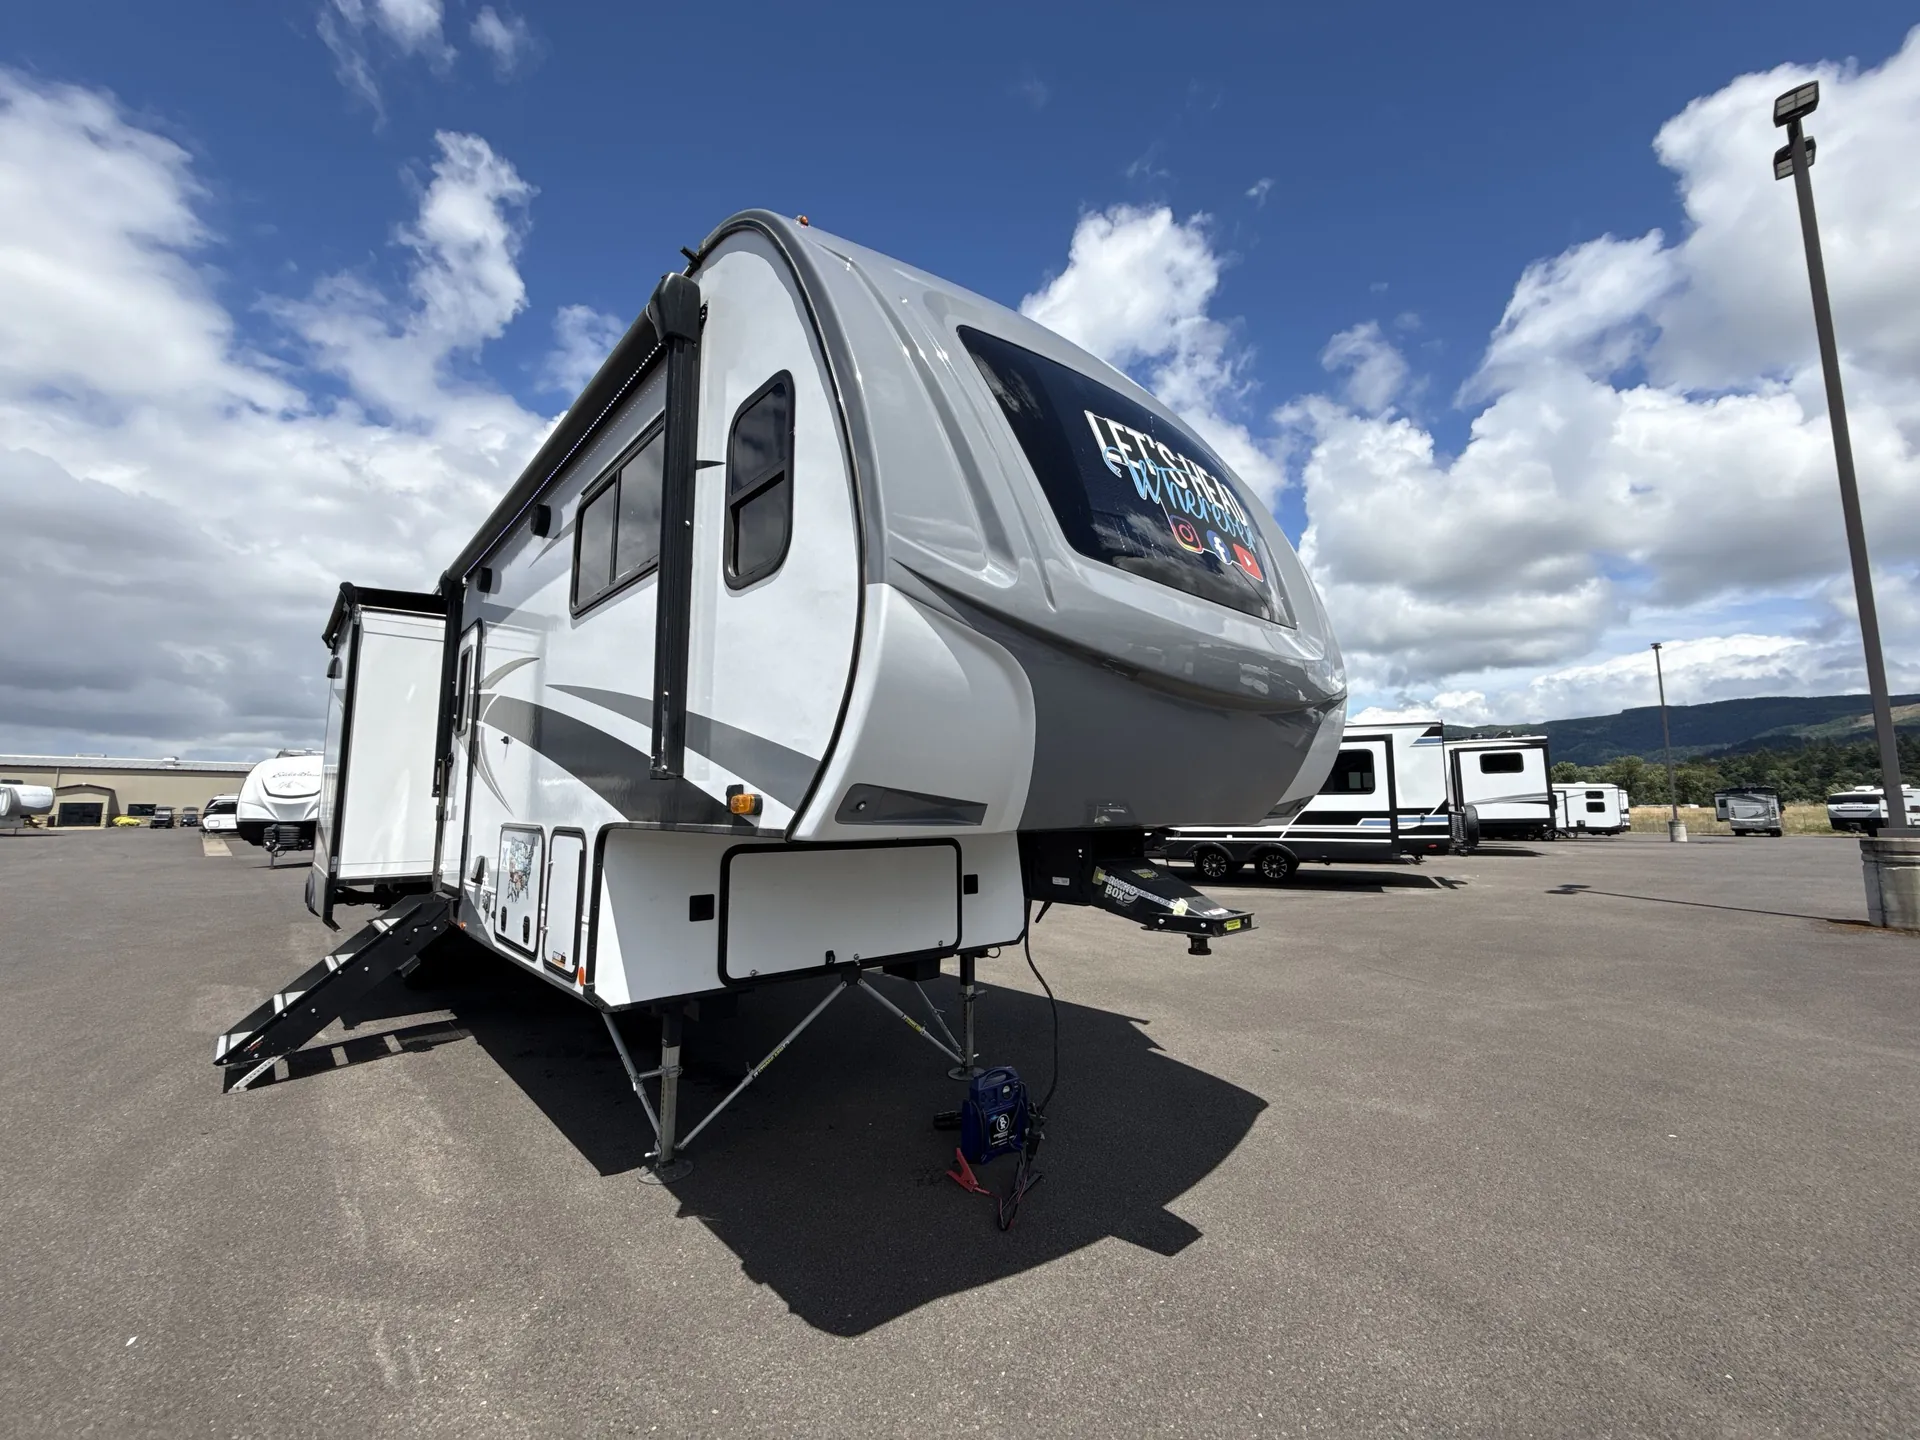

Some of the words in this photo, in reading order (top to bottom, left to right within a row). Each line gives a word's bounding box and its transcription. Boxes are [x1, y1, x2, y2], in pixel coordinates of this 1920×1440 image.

[1083, 409, 1187, 489] LET'S
[1177, 452, 1248, 527] HEAD
[1105, 884, 1125, 901] BOX
